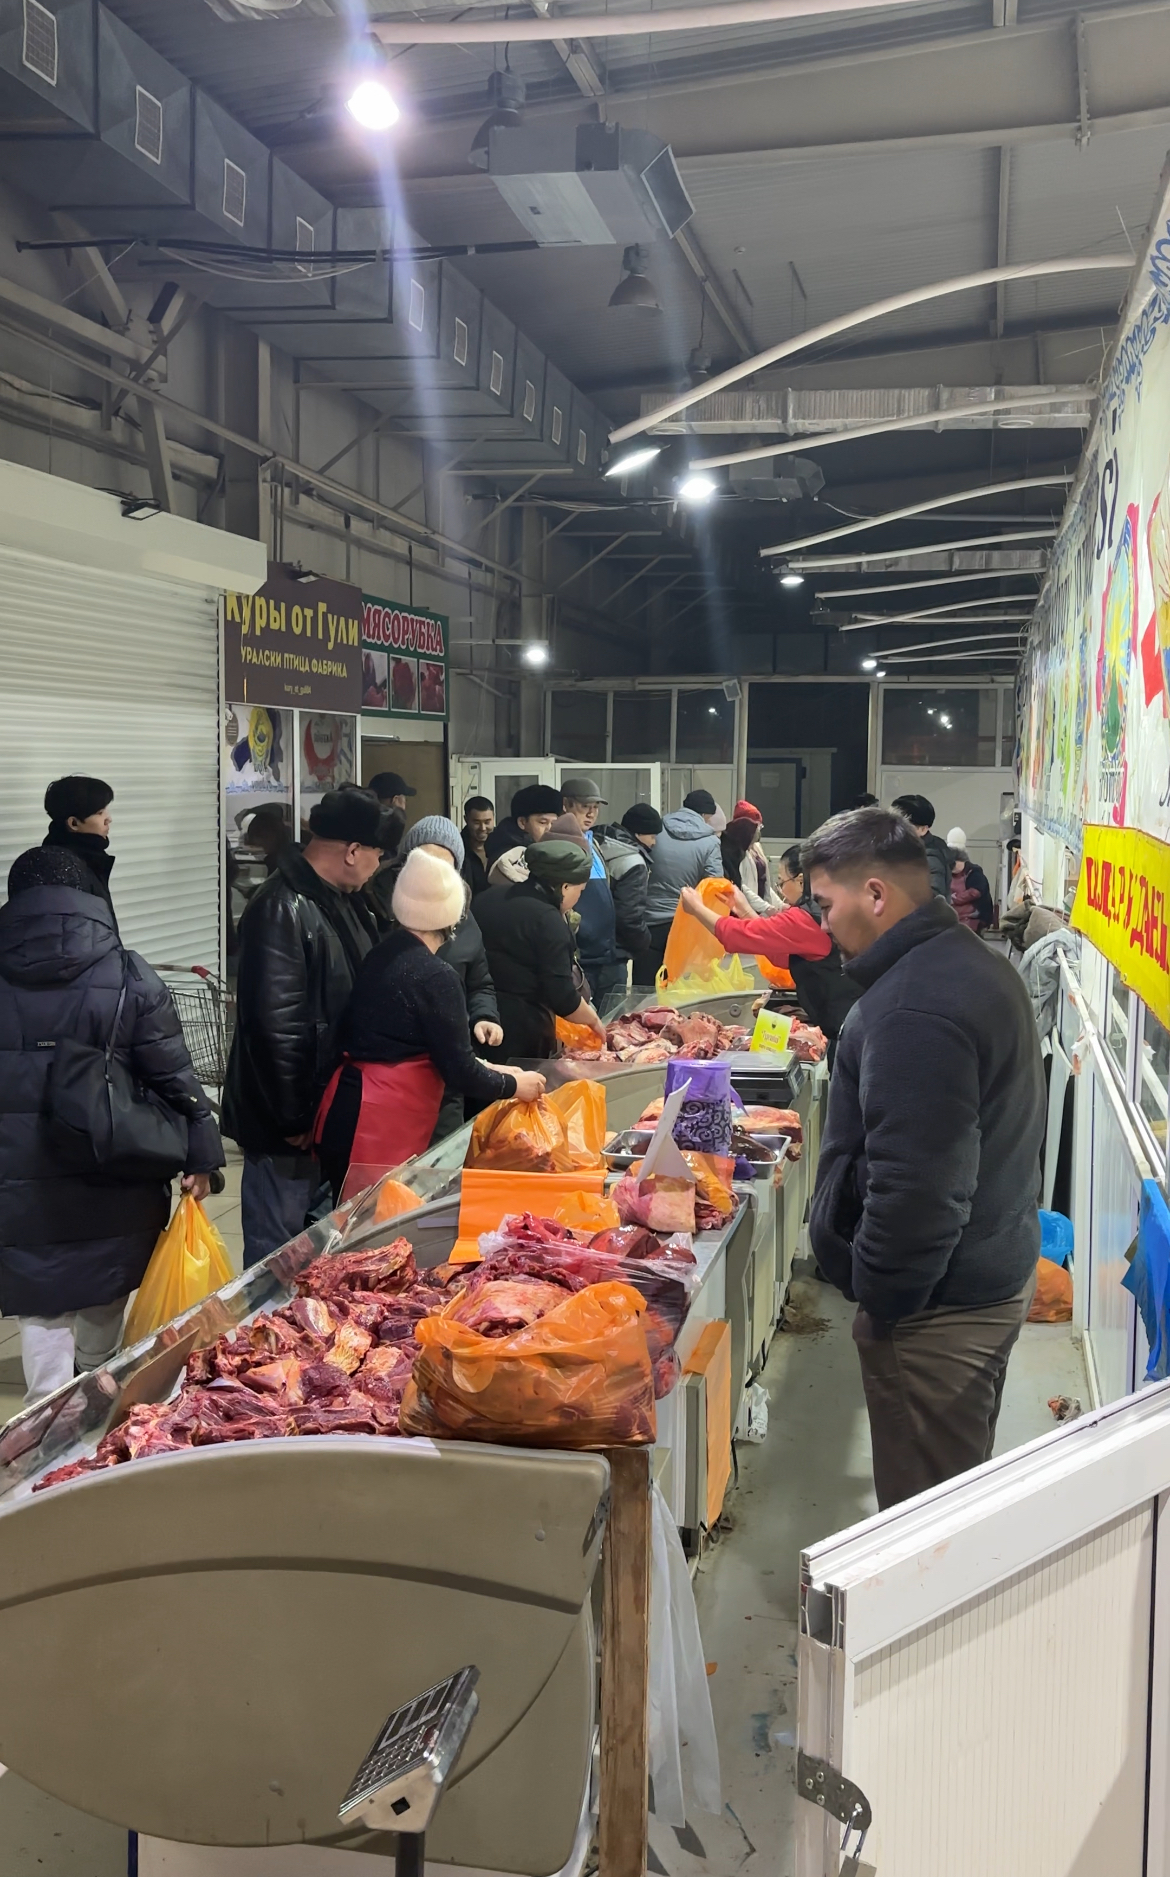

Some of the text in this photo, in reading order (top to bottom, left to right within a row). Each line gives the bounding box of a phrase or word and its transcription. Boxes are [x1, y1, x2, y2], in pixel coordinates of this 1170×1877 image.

[226, 592, 359, 650] Куры от Гули
[362, 604, 444, 656] МЯСОРУБКА
[241, 647, 348, 678] УРАЛСКИ ПТИЦА ФАБРИКА
